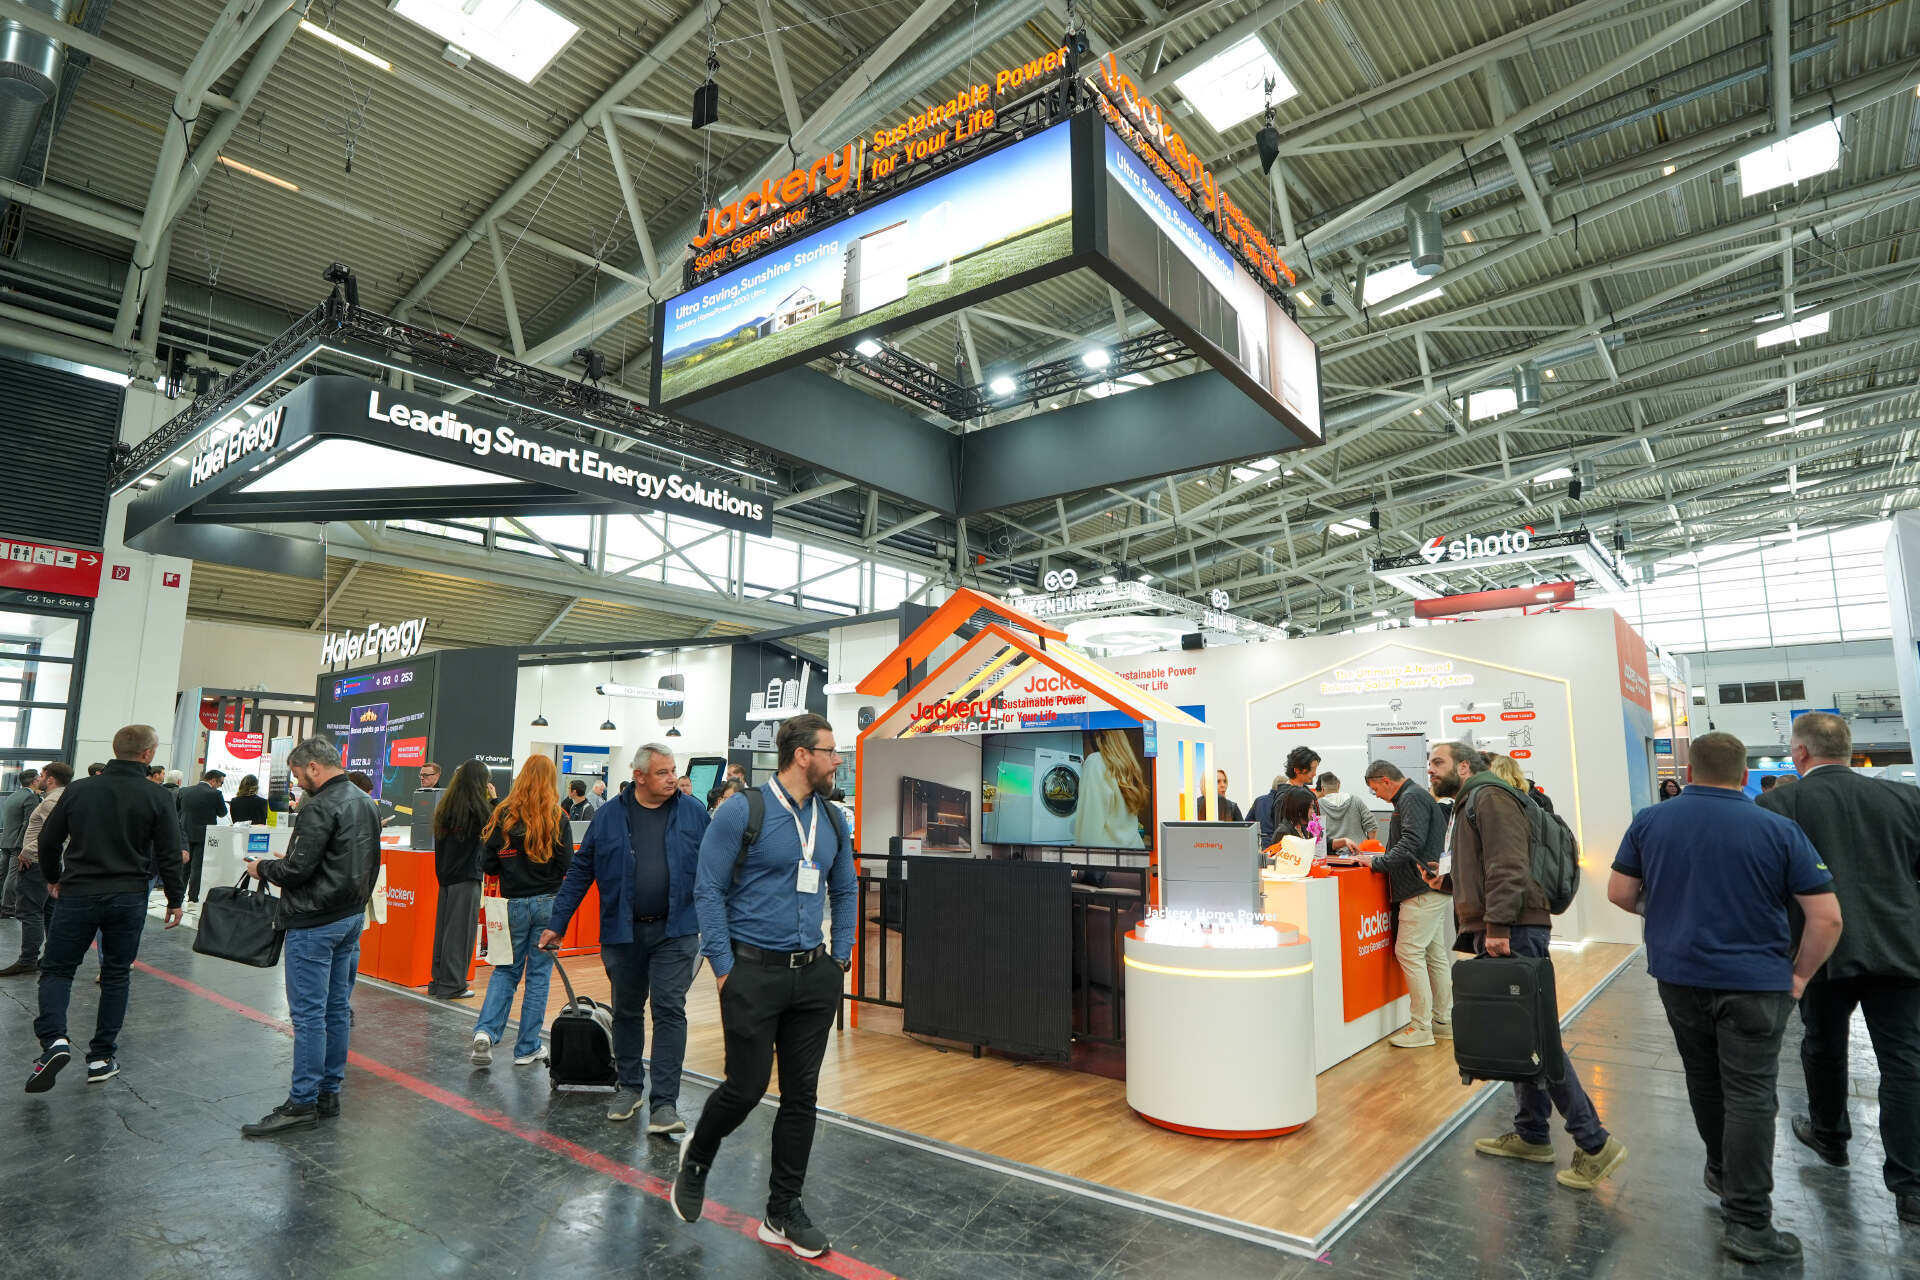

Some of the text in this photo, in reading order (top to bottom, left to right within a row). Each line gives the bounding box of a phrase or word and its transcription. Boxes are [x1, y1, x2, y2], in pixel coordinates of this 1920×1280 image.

[872, 45, 1069, 152] Sustainable Power
[1099, 51, 1216, 212] Jackery
[871, 108, 995, 181] for Your Life
[1116, 151, 1141, 187] Ultra
[1136, 130, 1192, 200] Generator
[692, 143, 853, 248] Jackery
[694, 206, 809, 273] Solar Generator
[675, 302, 700, 320] Ultra
[793, 239, 839, 268] Storing
[189, 405, 285, 488] Haier Energy
[368, 390, 764, 522] Leading Smart Energy Solutions
[1448, 530, 1531, 561] shoto
[26, 594, 91, 609] C2 Tor Gate 5
[320, 617, 428, 665] Haier Energy
[382, 671, 414, 686] 03 253
[1024, 669, 1081, 694] Jacke
[1167, 665, 1198, 677] Power
[1430, 675, 1474, 688] System
[1151, 679, 1169, 691] Life
[910, 699, 992, 723] Jackery
[1002, 696, 1054, 709] Sustainable
[1056, 694, 1087, 706] Power
[1002, 709, 1058, 723] for Your Life
[485, 755, 510, 763] charger
[1193, 840, 1223, 850] Jackery
[387, 886, 415, 905] Jackery
[1146, 906, 1193, 920] Jackery
